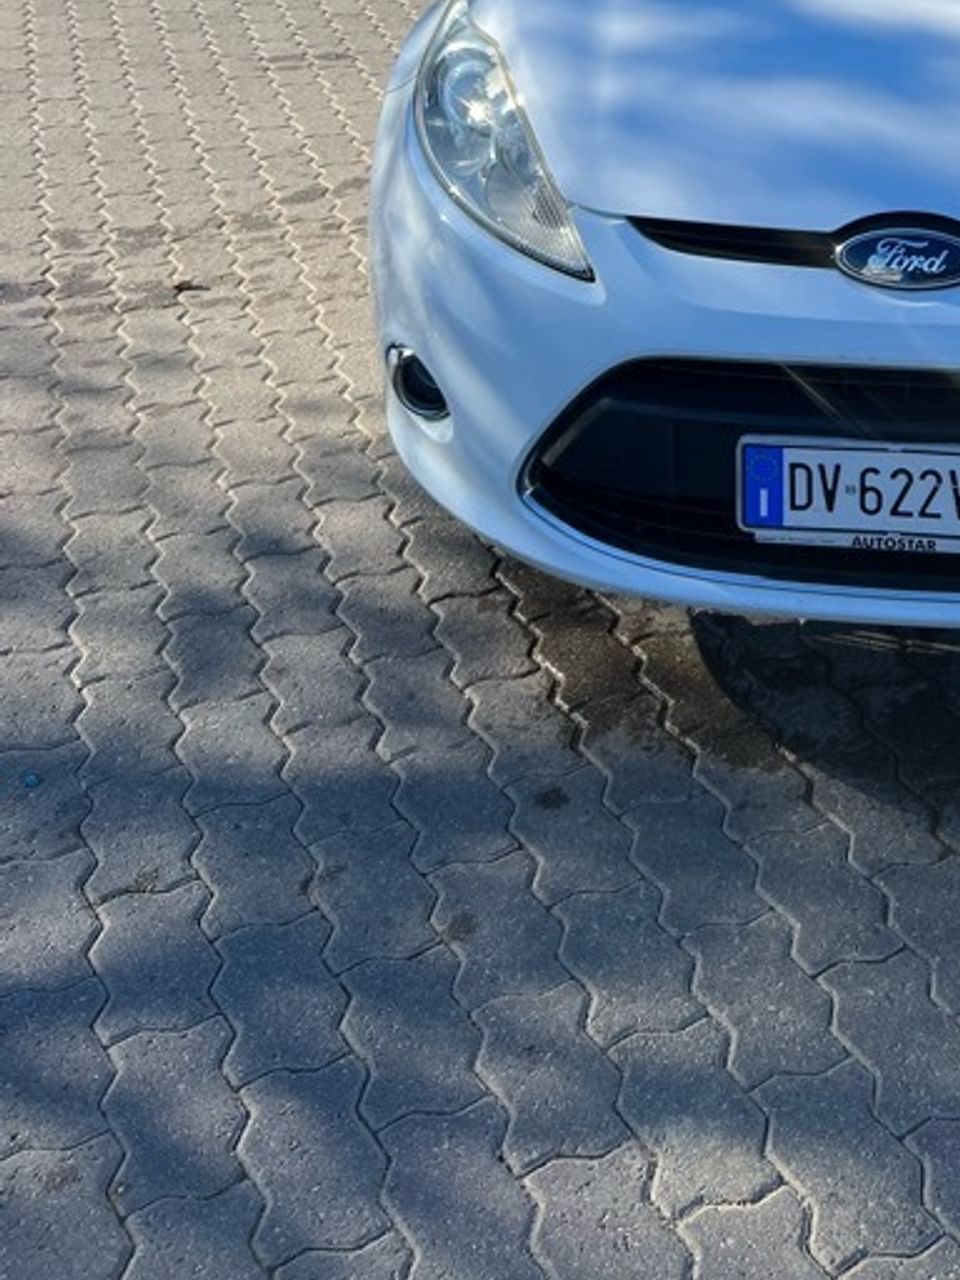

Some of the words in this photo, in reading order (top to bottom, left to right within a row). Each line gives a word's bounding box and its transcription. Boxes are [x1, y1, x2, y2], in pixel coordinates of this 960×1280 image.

[867, 238, 948, 274] Ford
[788, 462, 842, 513] DV
[851, 534, 937, 552] AUTOSTAR
